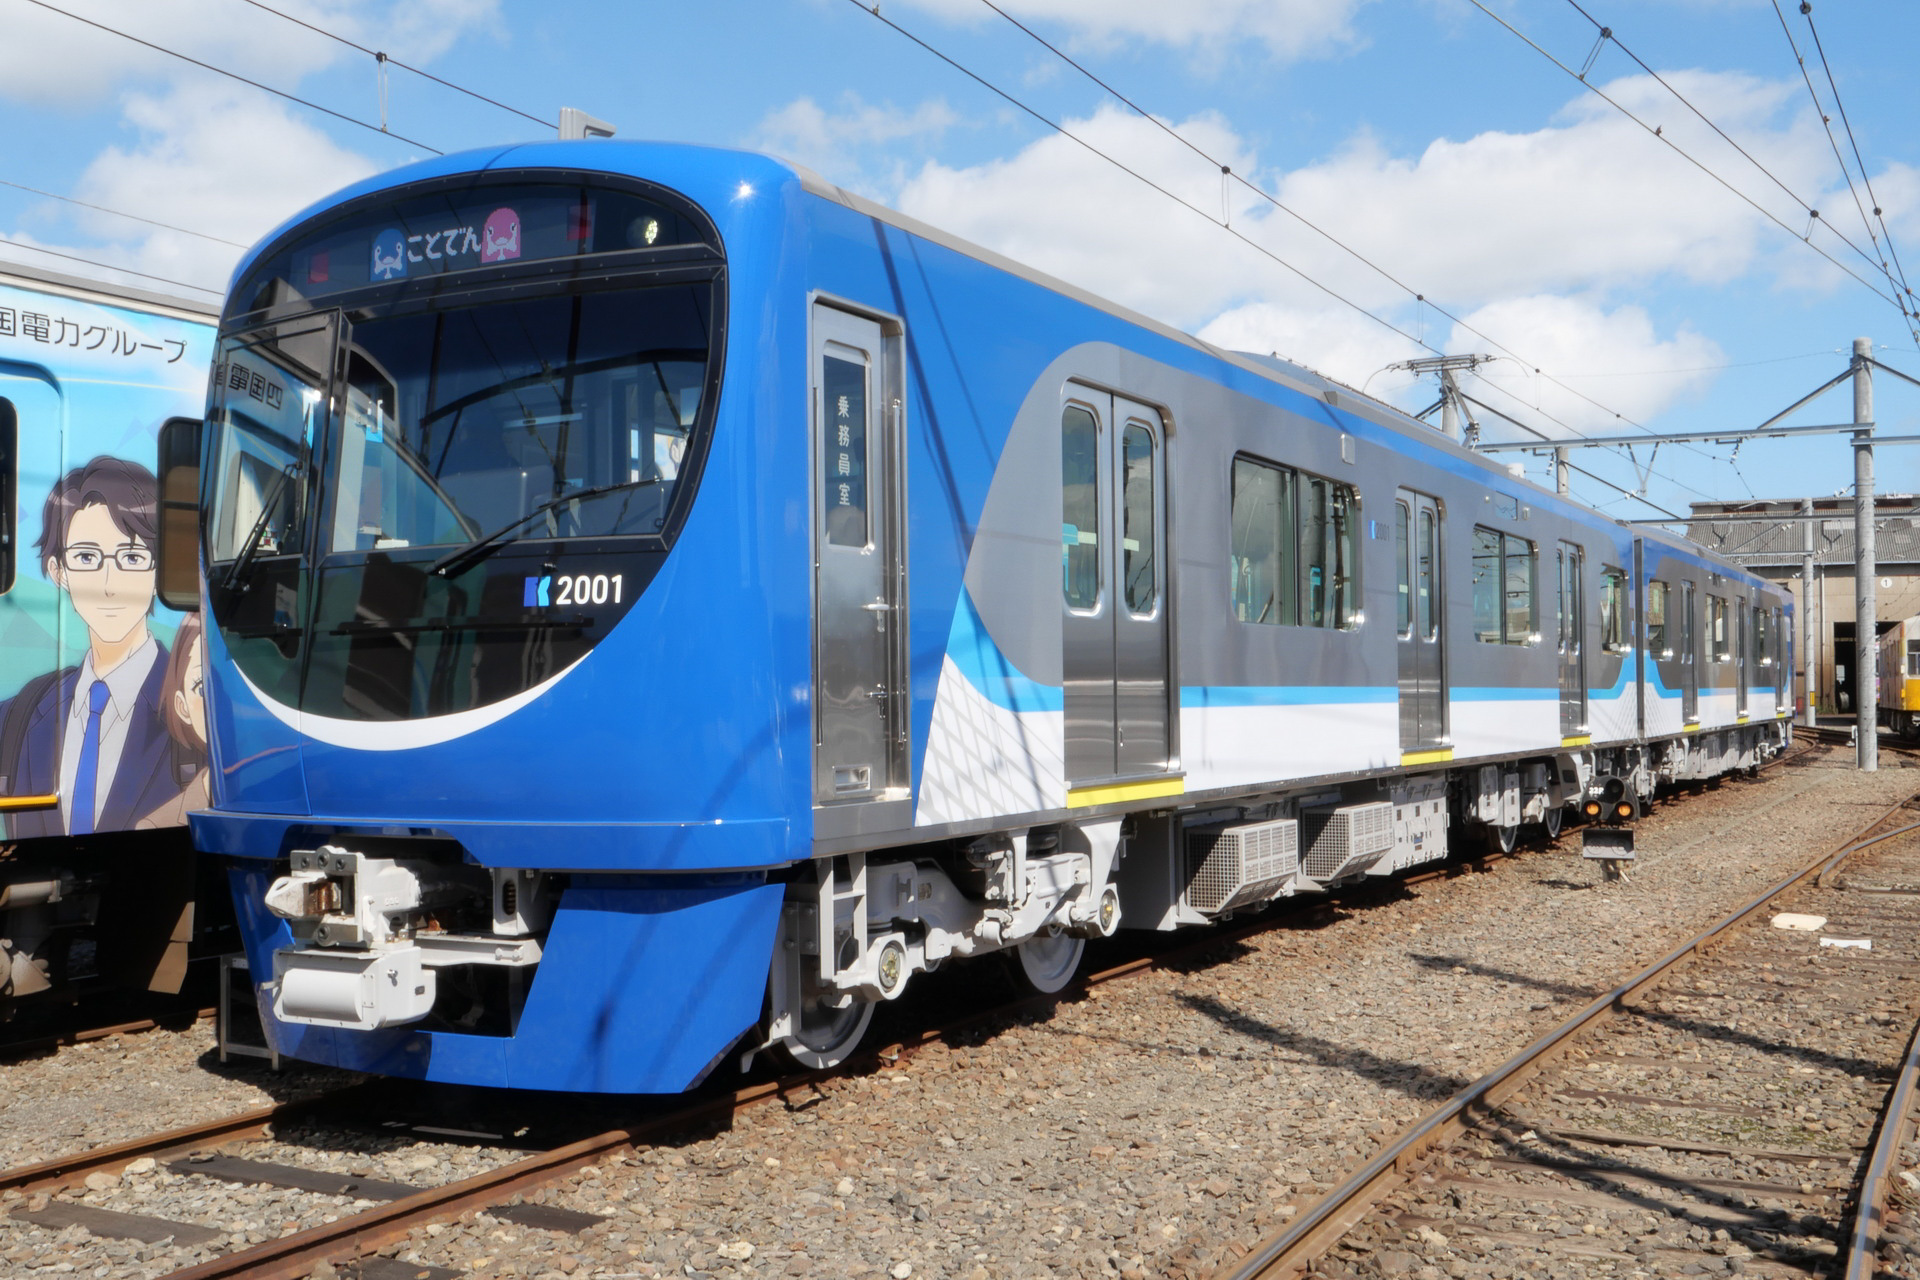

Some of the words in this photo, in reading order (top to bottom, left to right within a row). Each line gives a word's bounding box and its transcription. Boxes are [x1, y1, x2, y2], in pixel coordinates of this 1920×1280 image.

[407, 226, 482, 262] ことでん
[0, 307, 187, 363] 国電力グループ
[838, 395, 850, 506] 乗務員室
[556, 575, 622, 605] 2001
